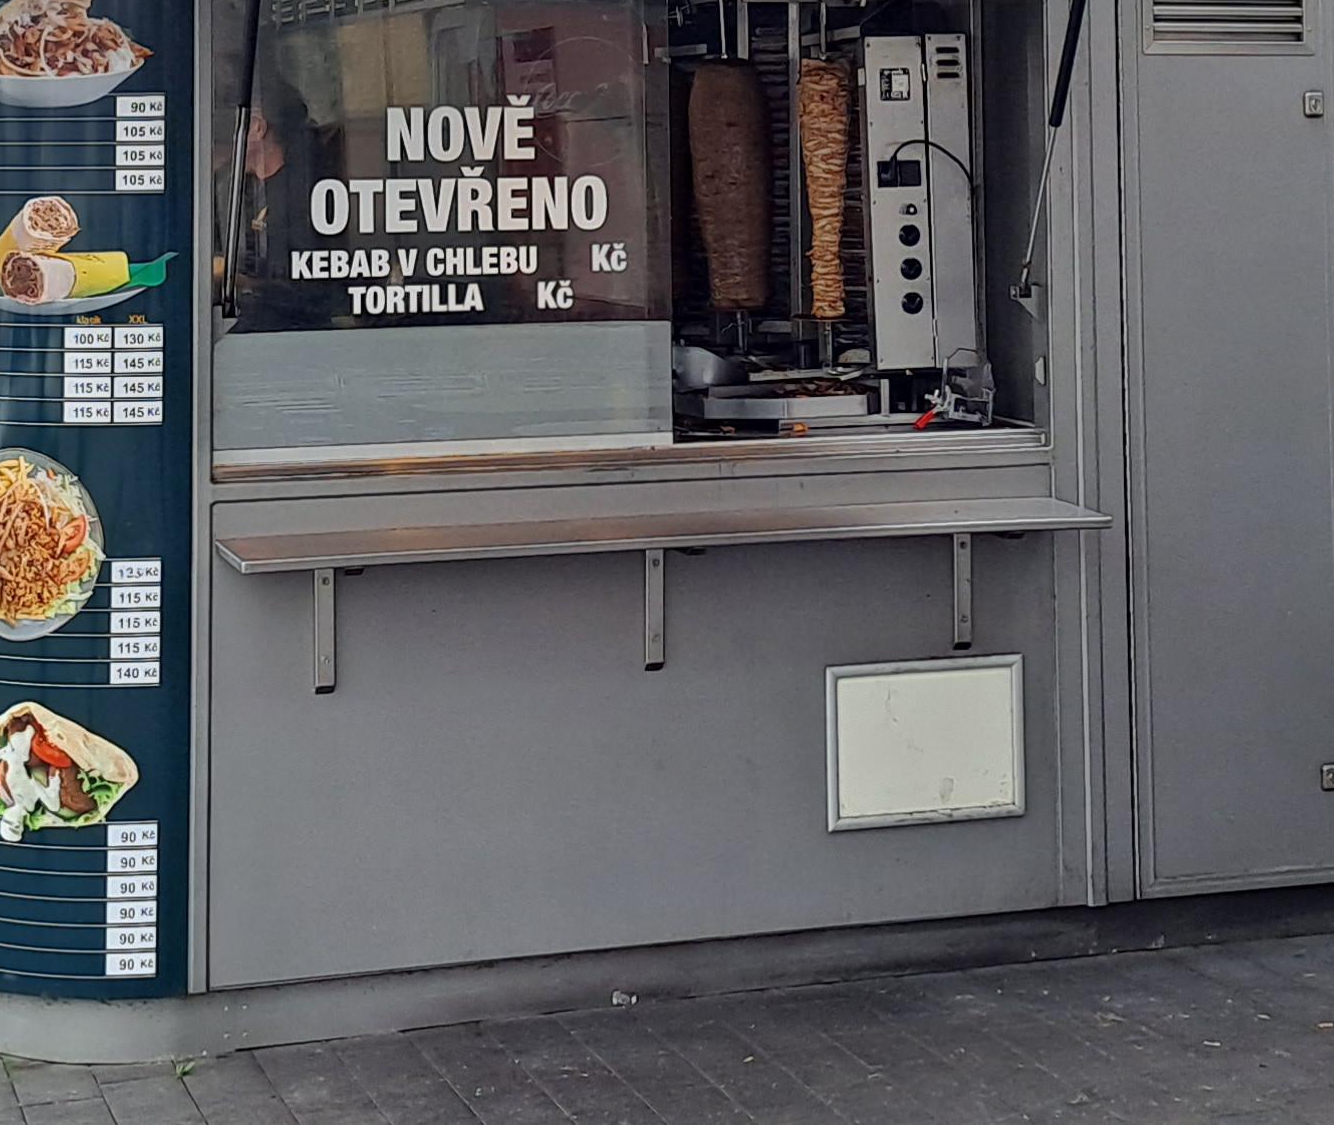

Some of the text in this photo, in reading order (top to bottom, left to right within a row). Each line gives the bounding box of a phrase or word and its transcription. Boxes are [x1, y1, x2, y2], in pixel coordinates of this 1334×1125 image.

[131, 102, 163, 113] 90 Kč
[123, 126, 163, 137] 105 Kč
[387, 95, 535, 161] NOVĚ
[123, 150, 163, 162] 105 Kč
[122, 174, 163, 186] 105 Kč
[310, 166, 608, 235] OTEVŘENO
[291, 242, 628, 279] KEBAB V CHLEBU Kč
[348, 280, 574, 315] TORTILLA Kč
[74, 334, 94, 345] 100
[124, 333, 144, 345] 130
[74, 358, 110, 370] 115 Kč
[123, 358, 161, 369] 145 Kč
[73, 382, 110, 394] 115 Kč
[123, 382, 161, 394] 145 Kč
[73, 407, 110, 418] 115 Kč
[123, 407, 160, 418] 145 Kč
[119, 592, 159, 604] 115 Kč
[119, 617, 158, 629] 115 Kč
[118, 642, 158, 654] 115 Kč
[117, 667, 157, 679] 140 Kč
[121, 830, 156, 843] 90 Kč
[120, 856, 155, 869] 90 Kč
[120, 881, 155, 894] 90 Kč
[120, 906, 154, 919] 90 Kč
[119, 932, 154, 945] 90 Kč
[119, 958, 154, 971] 90 Kč
